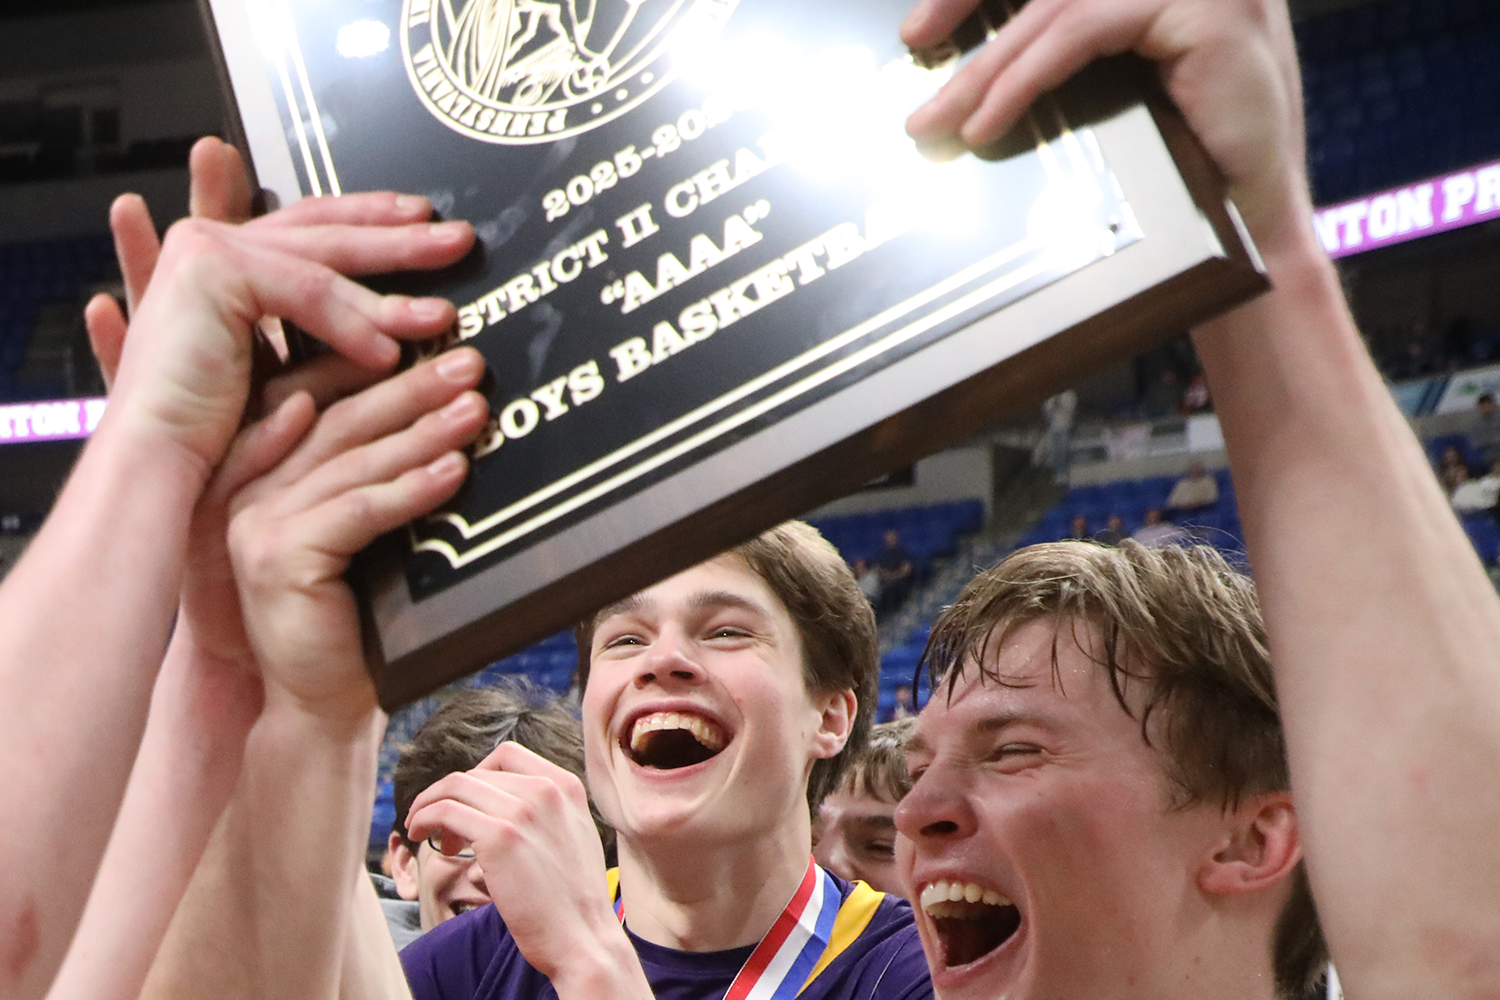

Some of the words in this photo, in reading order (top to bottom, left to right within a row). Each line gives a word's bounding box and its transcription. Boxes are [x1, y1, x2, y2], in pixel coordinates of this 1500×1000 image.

[413, 43, 568, 137] PENNSYLVANIA
[542, 93, 736, 222] 2025-202
[616, 203, 659, 248] II
[1313, 183, 1434, 252] NTON
[609, 204, 905, 382] BASKETBA
